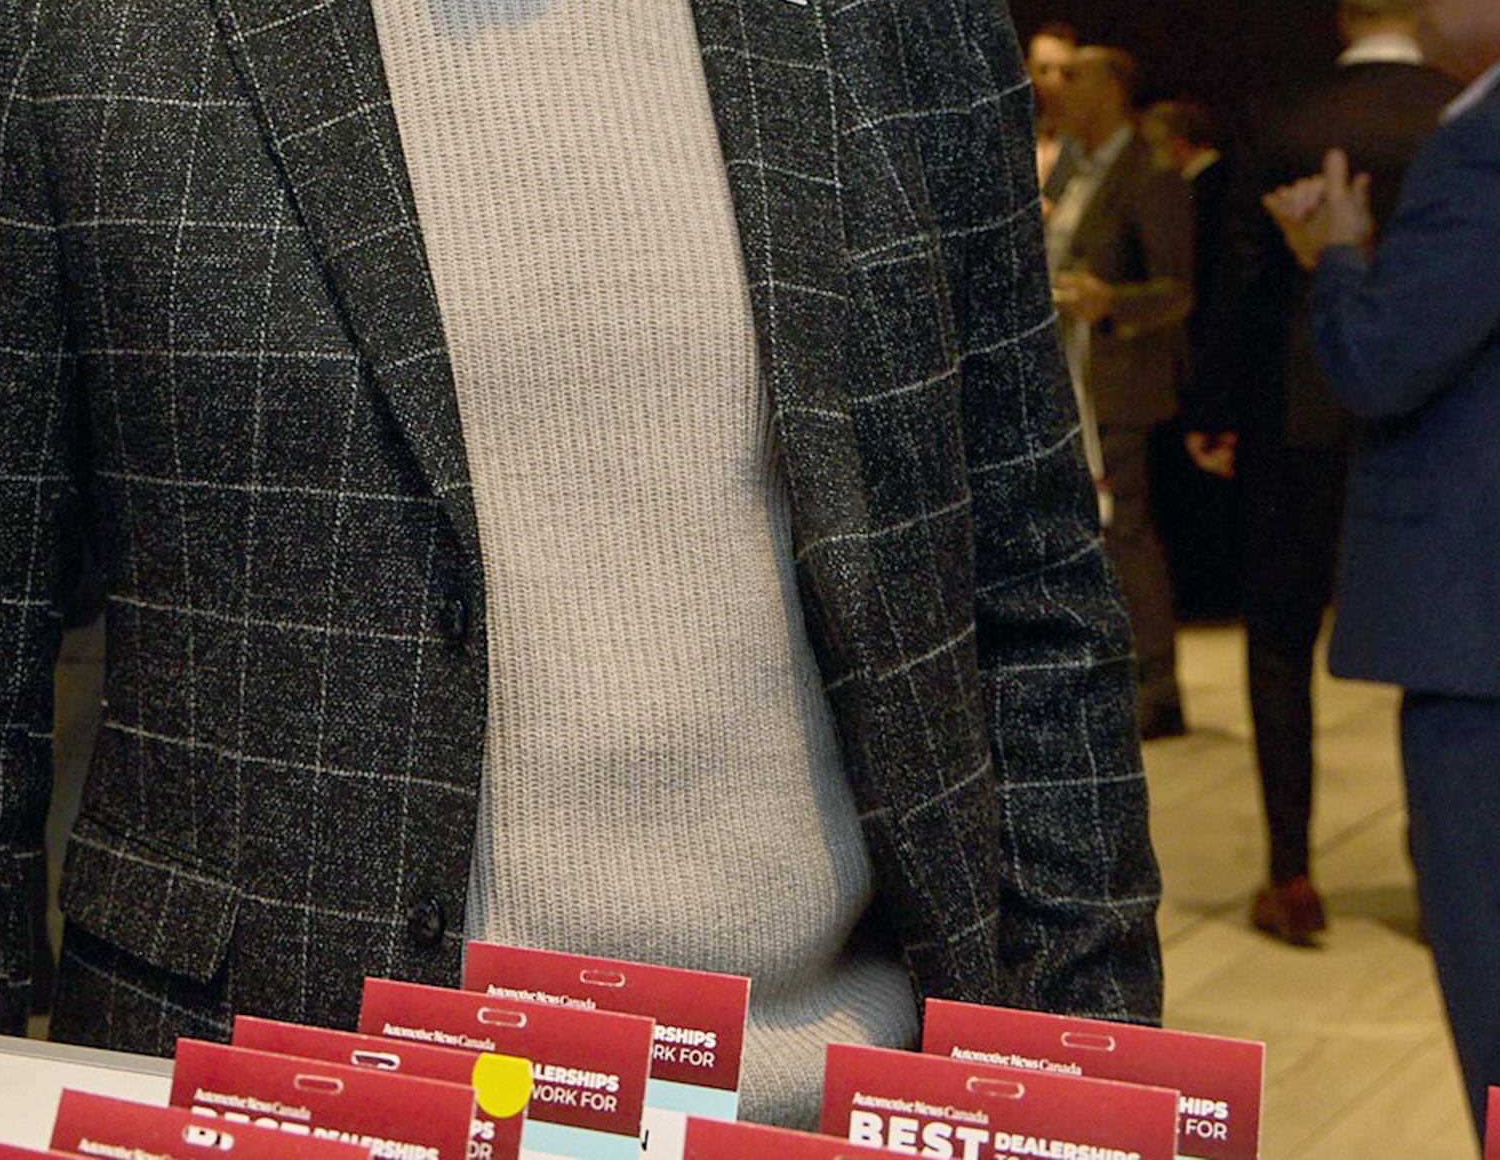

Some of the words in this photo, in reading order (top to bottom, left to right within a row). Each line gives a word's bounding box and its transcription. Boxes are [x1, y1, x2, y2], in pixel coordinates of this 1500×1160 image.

[537, 994, 560, 1007] News
[560, 995, 596, 1010] Canada
[435, 1031, 460, 1047] News
[459, 1034, 496, 1052] Canada
[655, 1025, 717, 1049] RSHIPS
[654, 1045, 675, 1062] RK
[679, 1050, 715, 1067] FOR
[952, 1046, 1010, 1067] Automotive
[1010, 1053, 1039, 1070] News
[1040, 1056, 1082, 1077] Canada
[531, 1064, 619, 1091] LERSHIPS
[273, 1101, 312, 1121] Canada
[580, 1091, 618, 1113] FOR
[852, 1092, 912, 1114] Automotive
[912, 1100, 943, 1119] News
[943, 1105, 990, 1125] Canada
[849, 1110, 990, 1160] BEST
[1185, 1119, 1228, 1140] FOR
